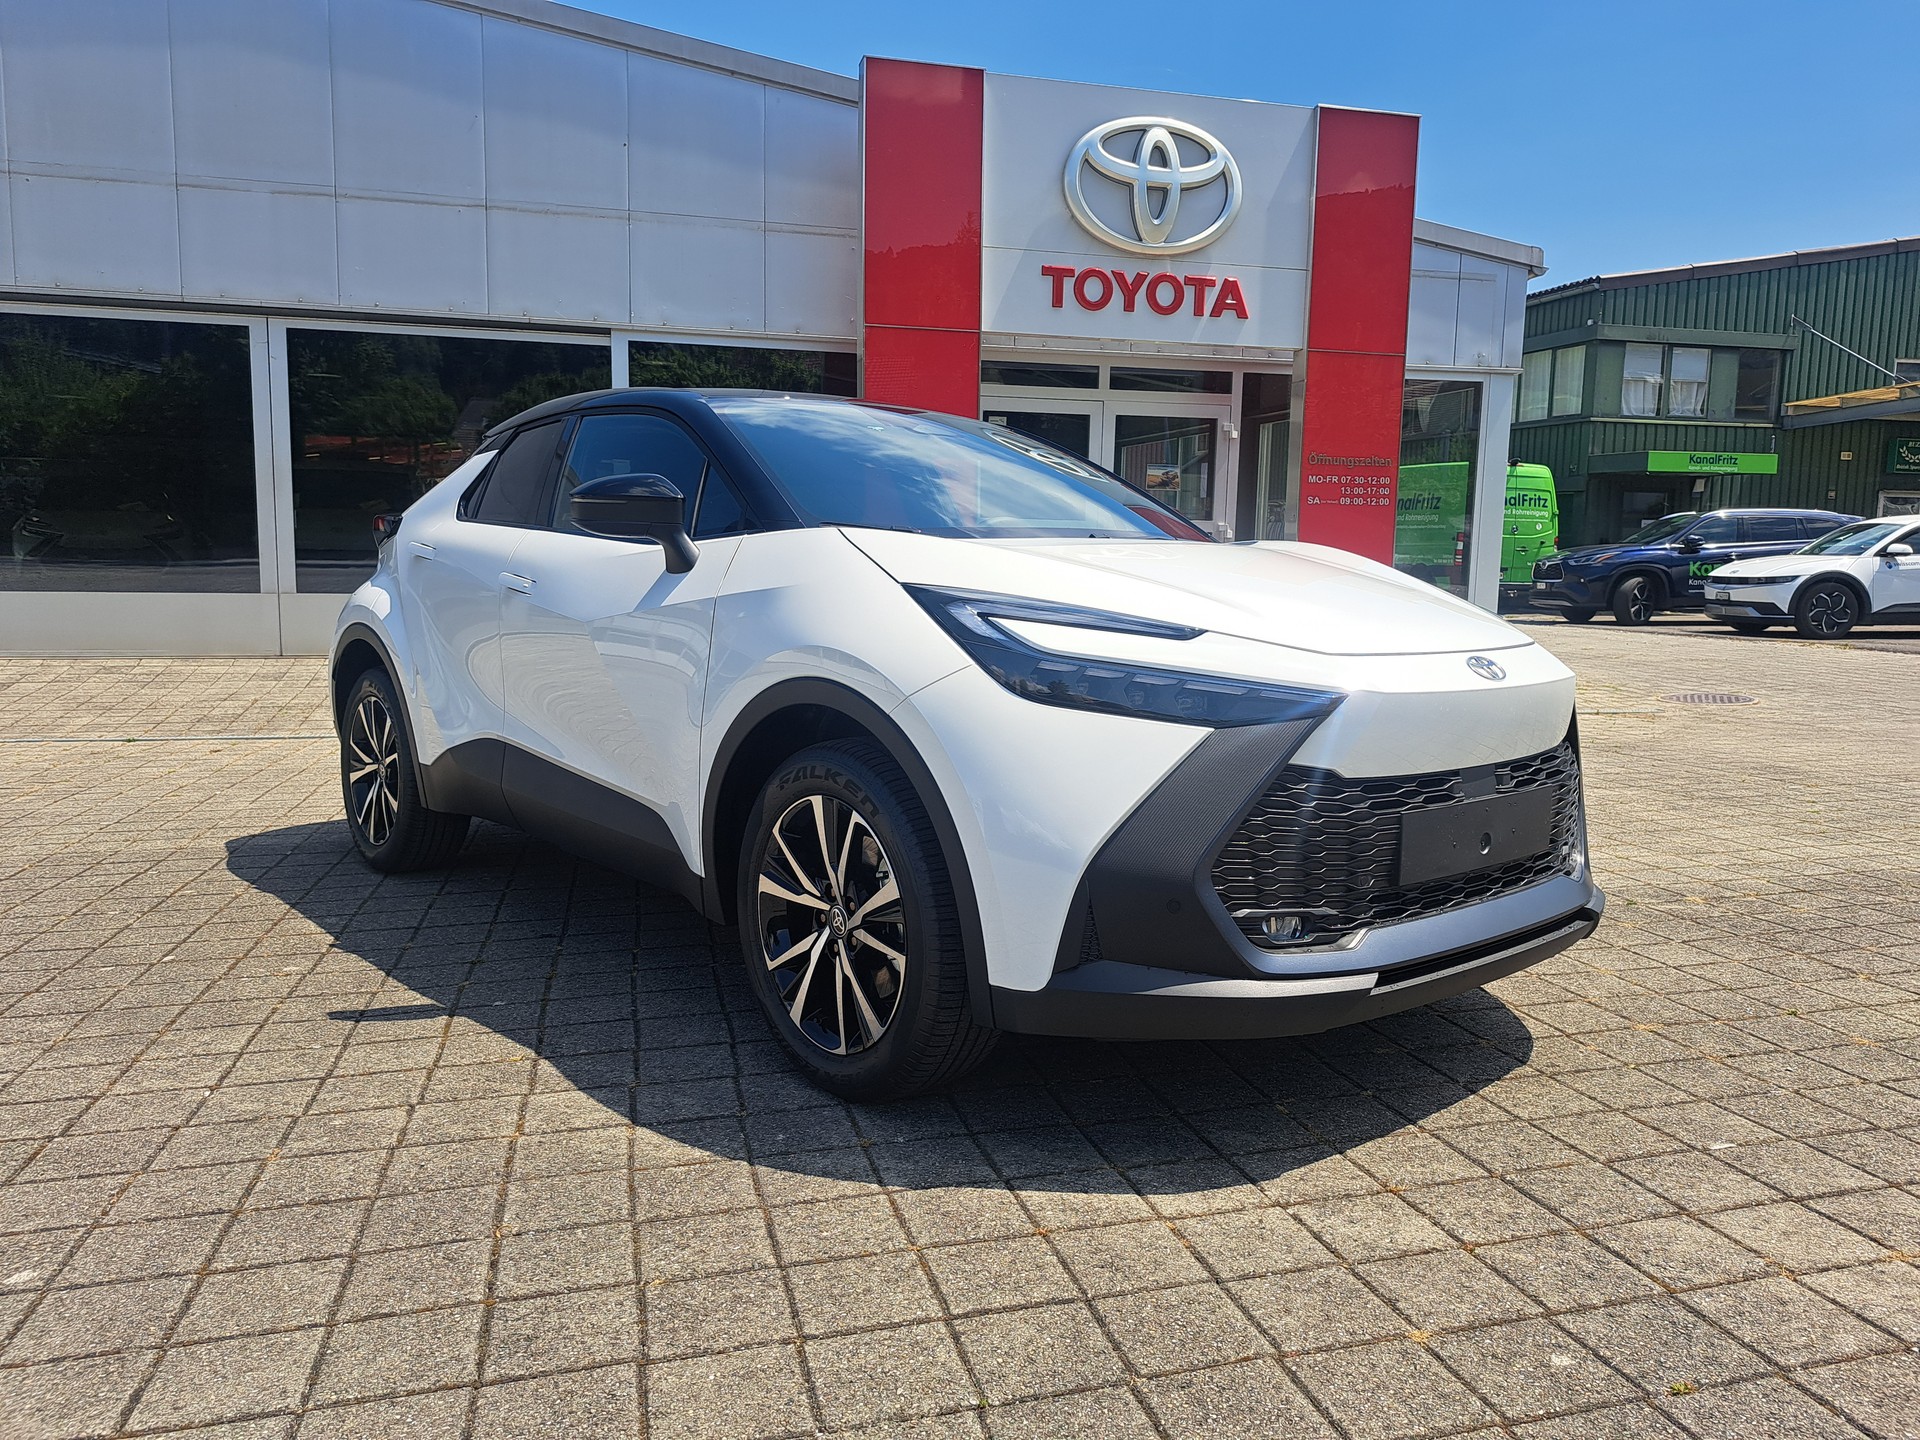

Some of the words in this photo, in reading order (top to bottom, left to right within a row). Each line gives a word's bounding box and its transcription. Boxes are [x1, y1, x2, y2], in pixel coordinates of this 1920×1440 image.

[1041, 264, 1249, 319] TOYOTA
[1308, 452, 1392, 468] Öffnungszeiten
[1689, 454, 1738, 465] KanalFritz
[1308, 475, 1339, 484] MO-FR
[1340, 475, 1391, 485] 07:30-12:00
[1340, 486, 1390, 495] 13:00-17:00
[1307, 496, 1321, 505] SA
[1340, 497, 1390, 506] 09:00-12:00
[775, 765, 880, 819] FALKEN
